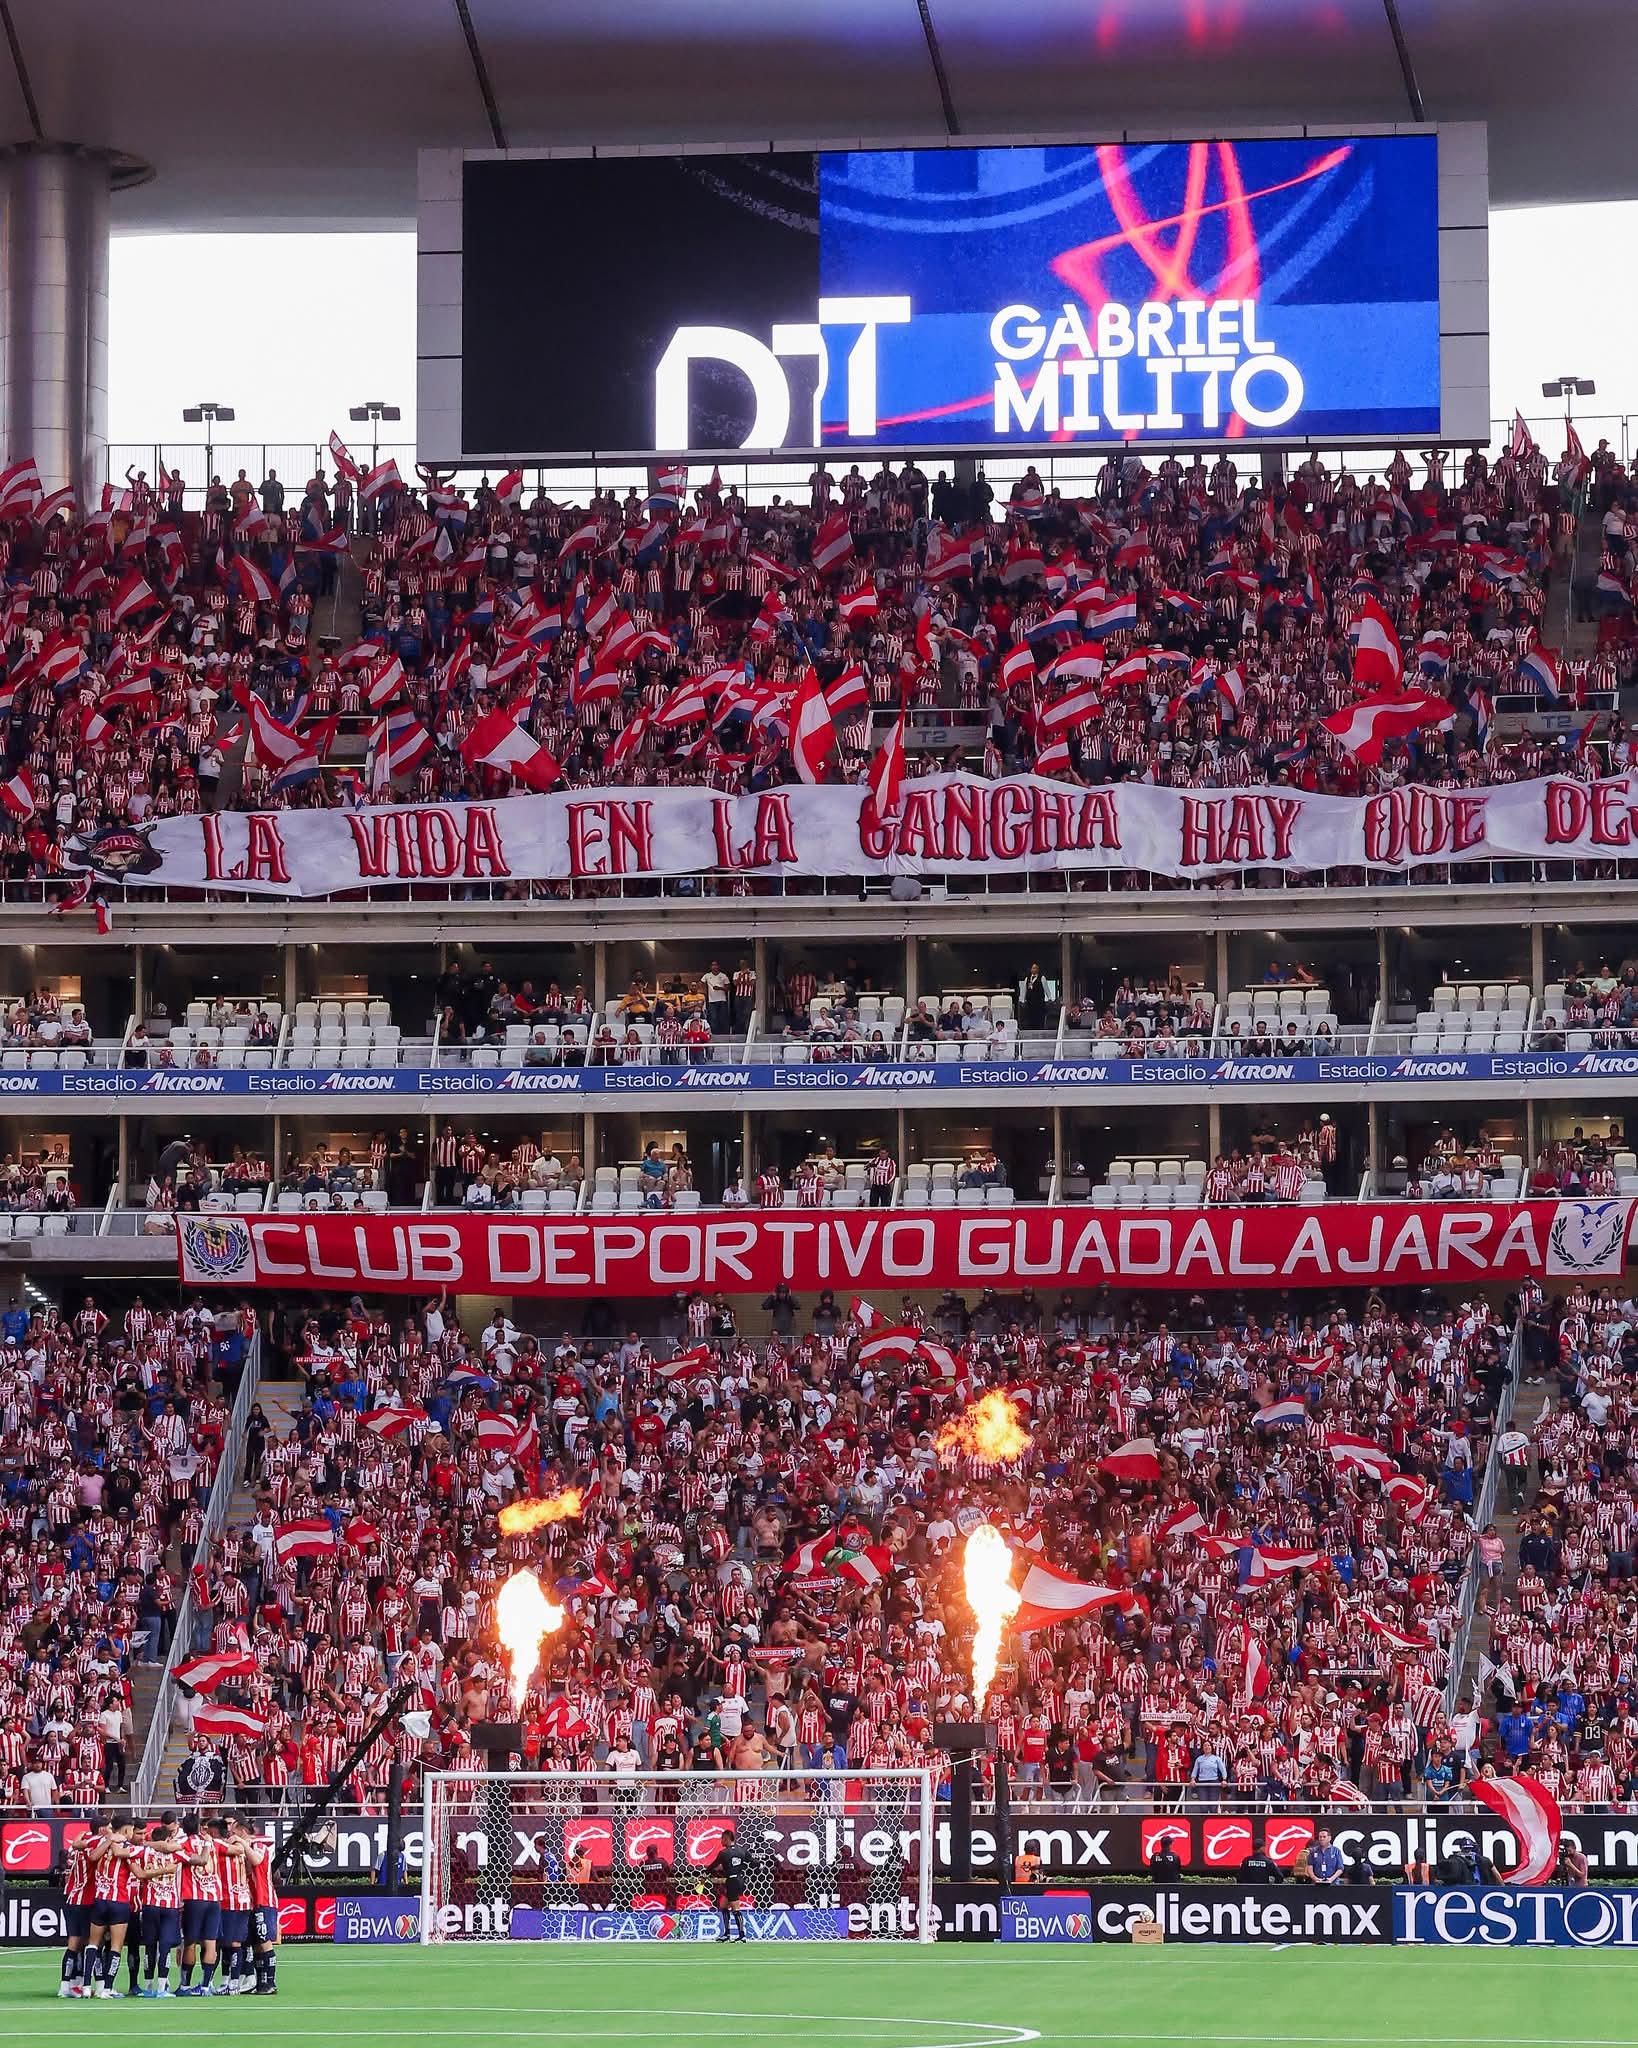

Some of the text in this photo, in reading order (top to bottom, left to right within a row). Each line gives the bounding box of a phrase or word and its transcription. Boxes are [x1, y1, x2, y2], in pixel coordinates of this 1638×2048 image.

[990, 299, 1275, 360] GABRIEL
[993, 354, 1304, 433] MILITO
[200, 812, 292, 883] LA
[345, 806, 511, 879] VIDA
[567, 799, 654, 878] EN
[713, 793, 798, 872] LA
[858, 782, 1121, 862] CANCHA
[1181, 796, 1303, 867] HAY
[1363, 786, 1489, 865] QUE
[62, 1074, 136, 1091] Estadio
[140, 1072, 223, 1091] AKRON
[248, 1075, 316, 1091] Estadio
[319, 1072, 394, 1090] AKRON
[418, 1073, 493, 1090] Estadio
[496, 1071, 579, 1089] AKRON
[604, 1072, 672, 1088] Estadio
[675, 1069, 749, 1086] AKRON
[774, 1069, 848, 1086] Estadio
[852, 1067, 935, 1085] AKRON
[960, 1067, 1028, 1083] Estadio
[1031, 1064, 1107, 1082] AKRON
[1131, 1064, 1206, 1081] Estadio
[1209, 1061, 1294, 1080] AKRON
[1319, 1062, 1387, 1078] Estadio
[1391, 1059, 1467, 1076] AKRON
[1491, 1058, 1567, 1074] Estadio
[251, 1223, 463, 1281] CLUB
[489, 1219, 934, 1284] DEPORTIVO
[959, 1210, 1543, 1276] GUADALAJARA
[0, 1899, 67, 1937] lie
[336, 1902, 362, 1916] LIGA
[1002, 1901, 1029, 1915] LIGA
[1097, 1893, 1382, 1936] caliente.mx
[348, 1918, 392, 1938] BBVA
[560, 1914, 639, 1938] LIGA
[1015, 1917, 1064, 1938] BBVA
